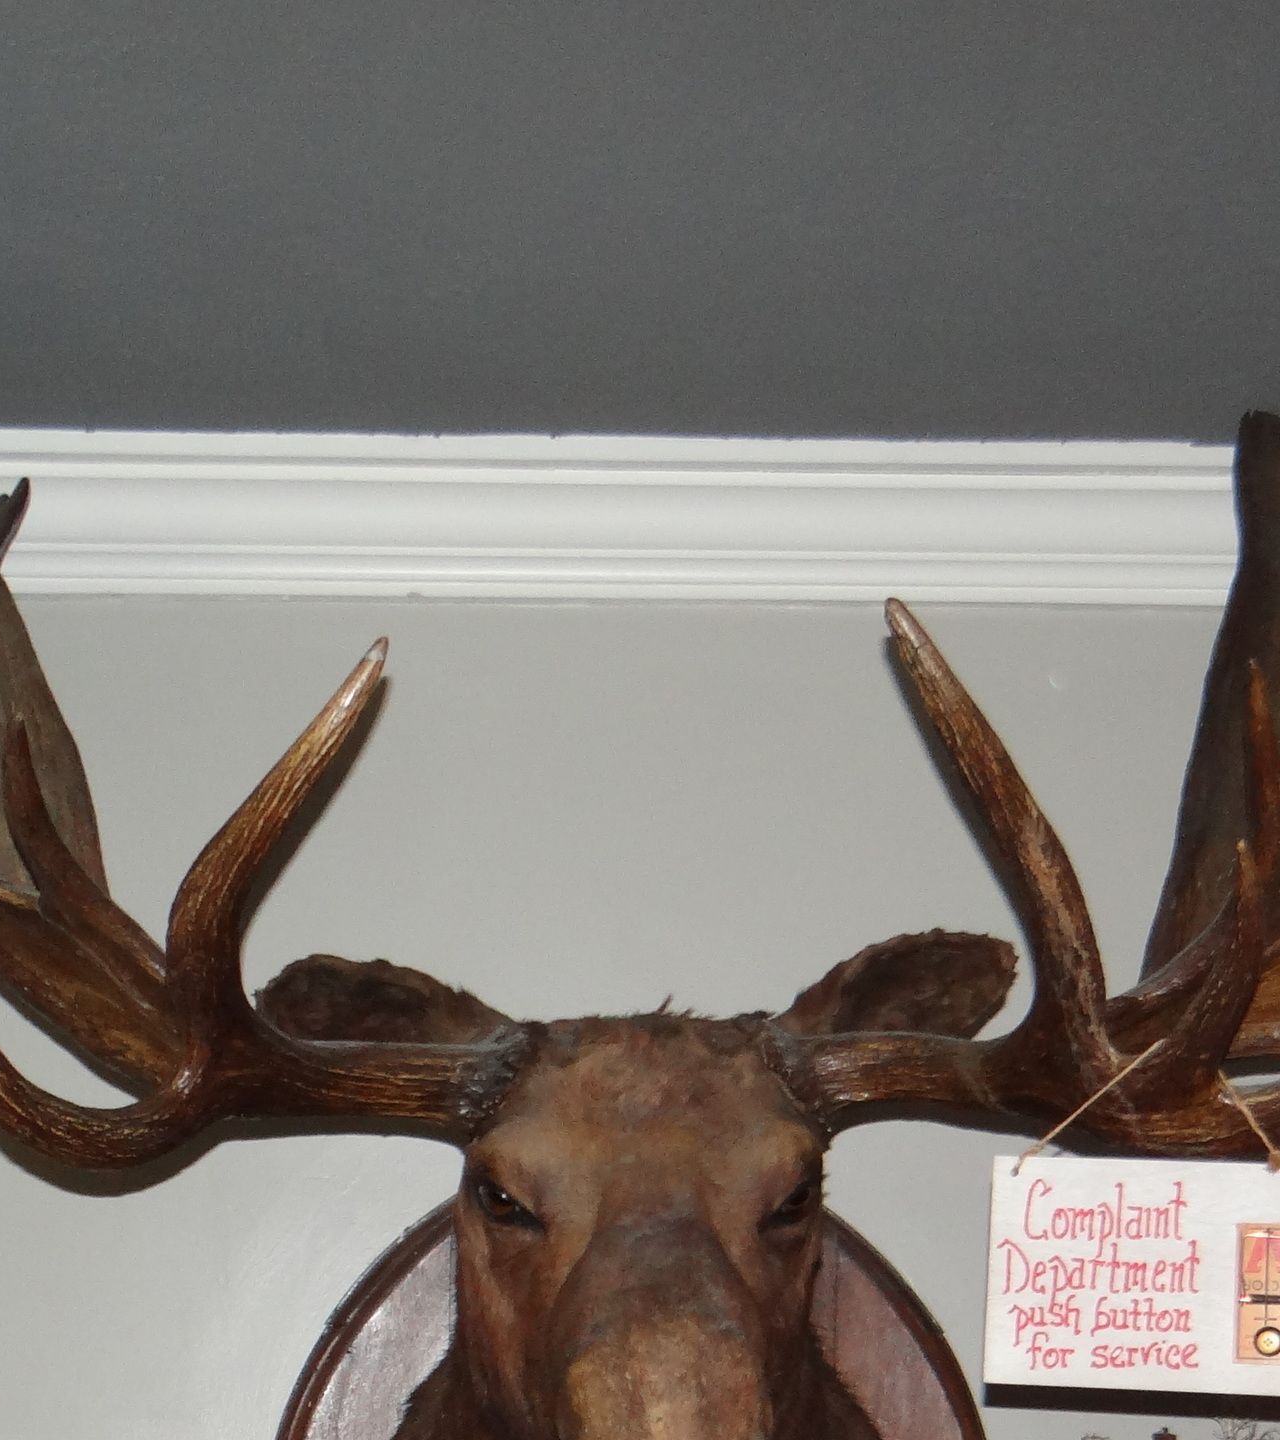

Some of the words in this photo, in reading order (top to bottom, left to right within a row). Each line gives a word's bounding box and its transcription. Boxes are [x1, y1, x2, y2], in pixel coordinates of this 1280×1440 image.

[1023, 1178, 1187, 1257] Complaint
[997, 1239, 1200, 1312] Department
[1008, 1295, 1081, 1347] push
[1091, 1296, 1192, 1337] button
[1026, 1332, 1074, 1370] for
[1091, 1340, 1199, 1370] service
